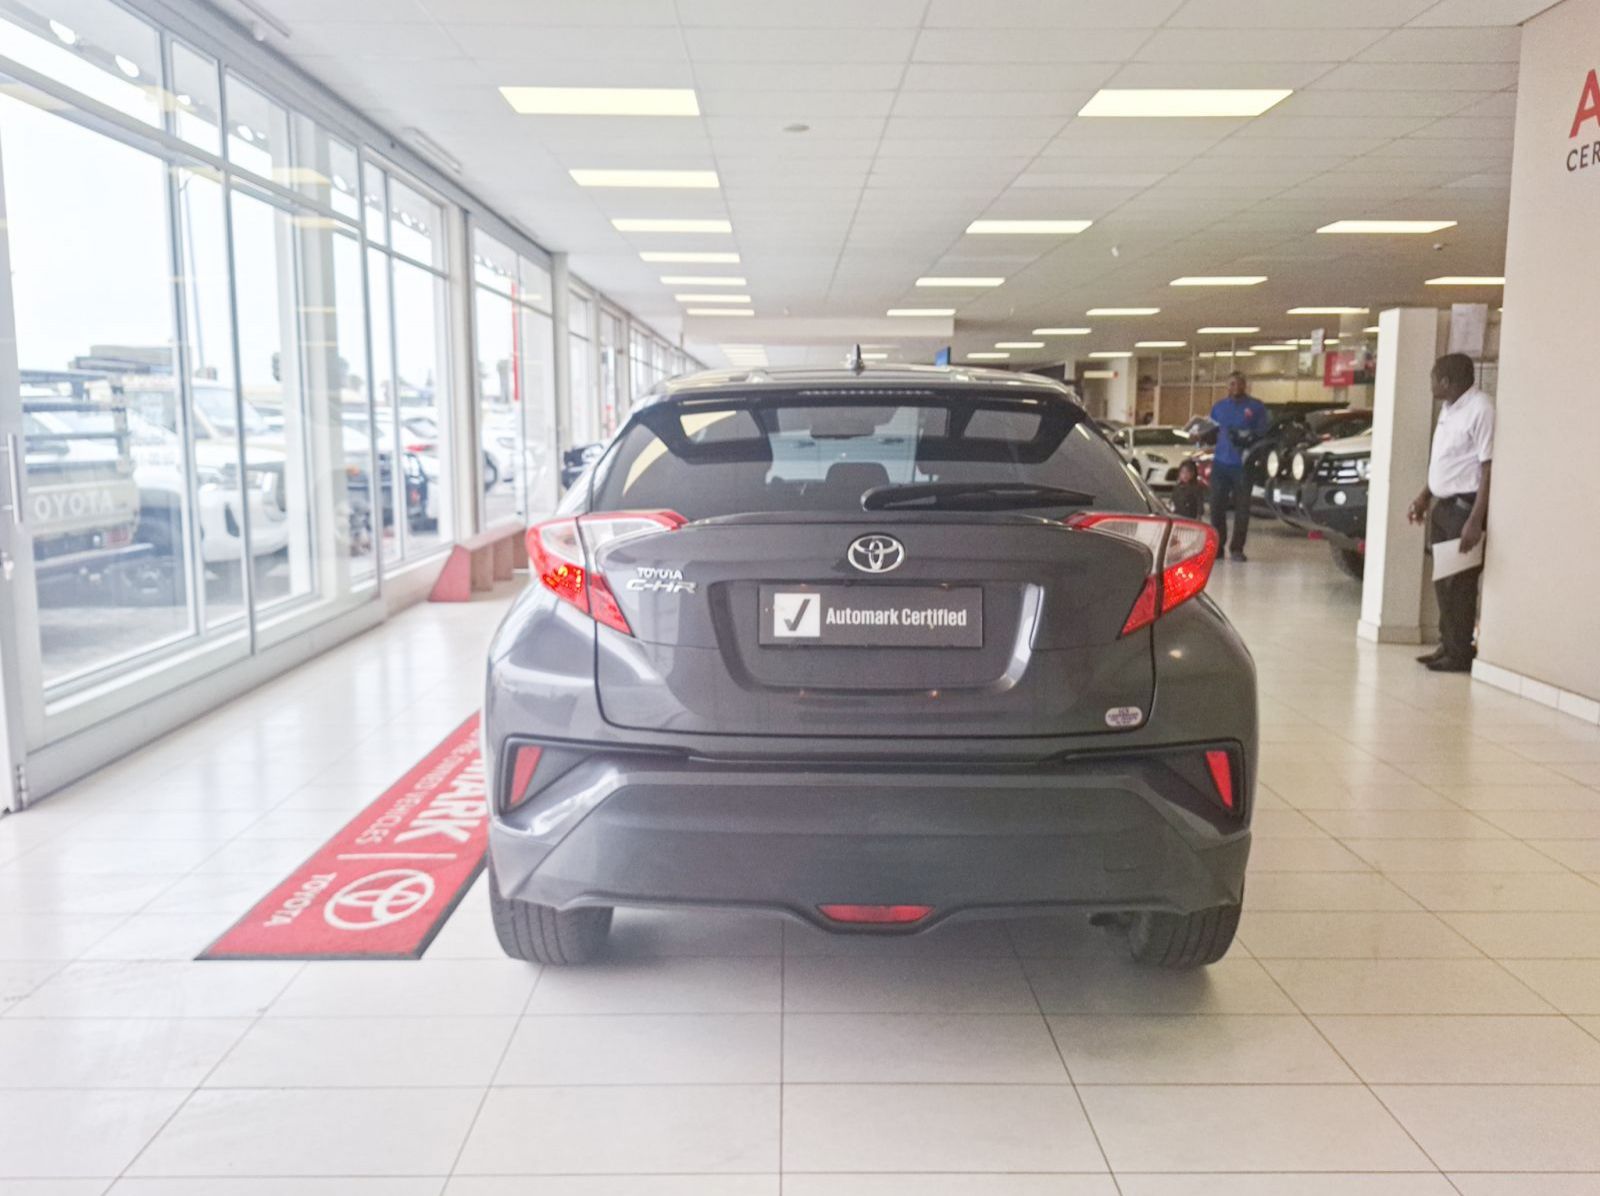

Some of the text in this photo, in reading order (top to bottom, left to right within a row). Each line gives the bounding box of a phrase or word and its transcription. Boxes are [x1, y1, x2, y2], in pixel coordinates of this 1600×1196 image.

[1569, 68, 1600, 139] A
[637, 567, 683, 580] TOYOTA
[626, 579, 697, 593] C-HR
[826, 607, 967, 627] Automark Certified
[263, 872, 337, 927] TOYOTA
